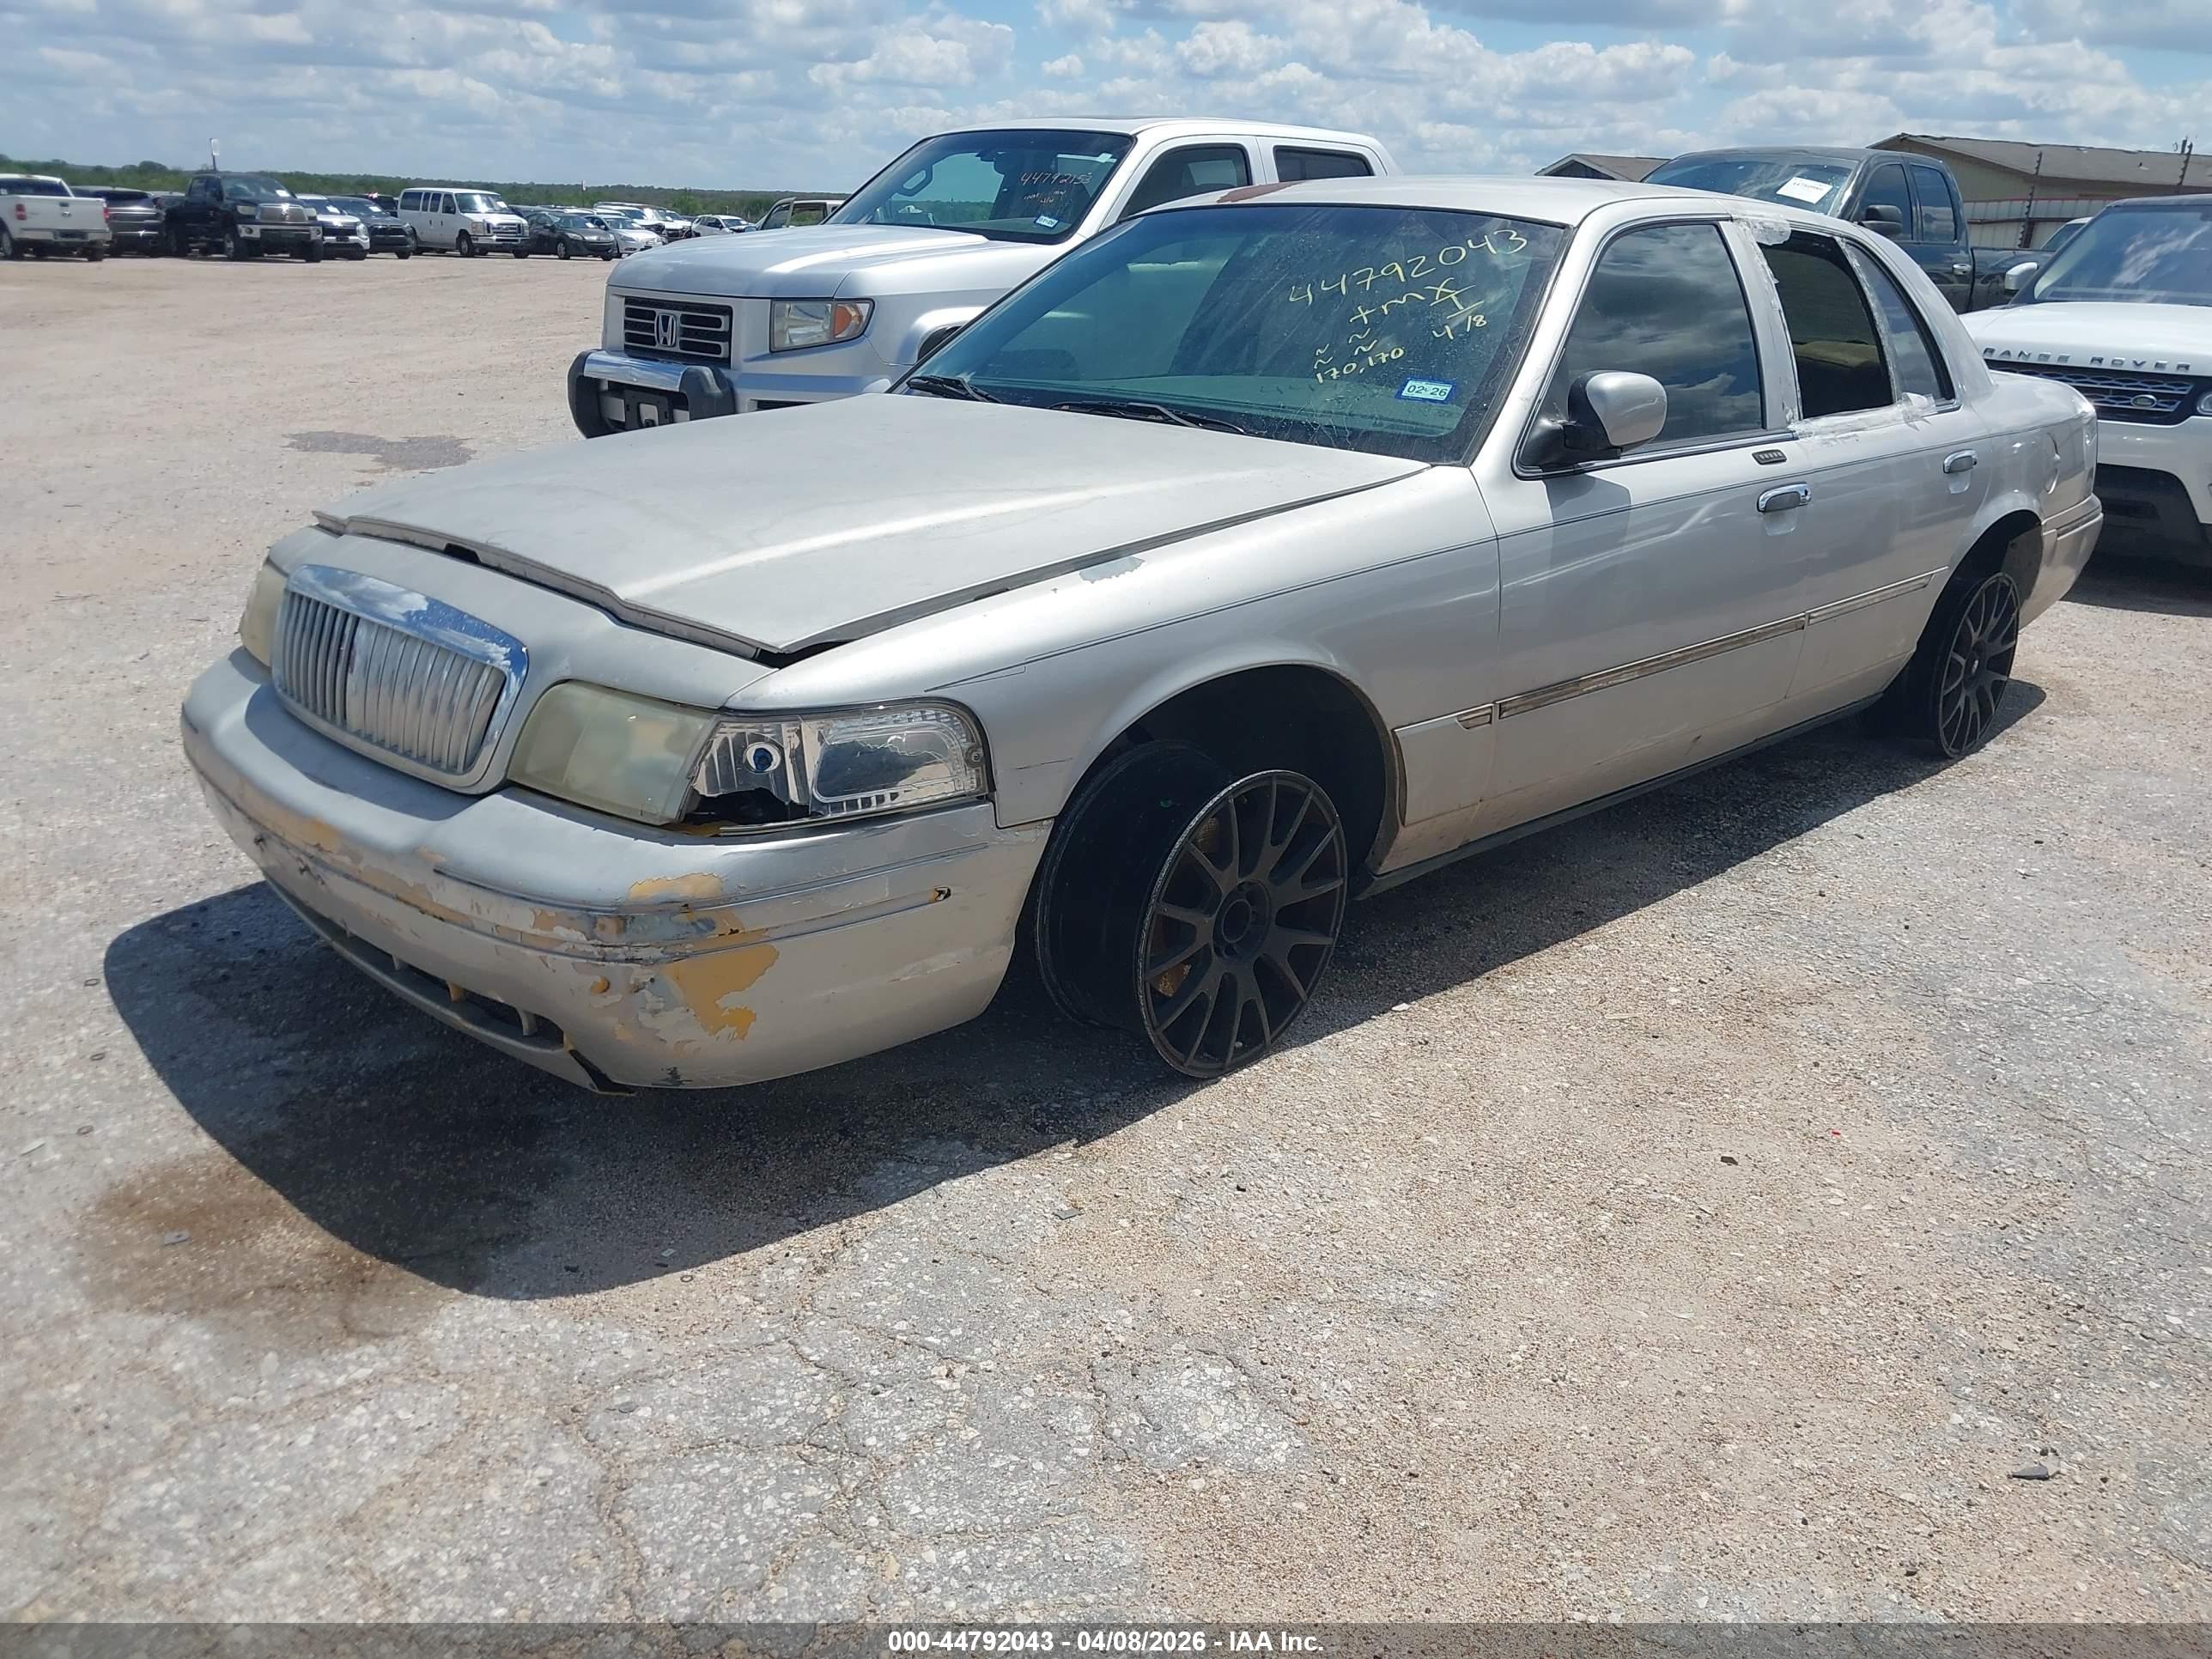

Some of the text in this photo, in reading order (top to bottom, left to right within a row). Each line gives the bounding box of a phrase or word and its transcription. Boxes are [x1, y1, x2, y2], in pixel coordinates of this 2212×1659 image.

[1289, 229, 1528, 306] 44792043
[1983, 347, 2191, 371] RANGE ROVER
